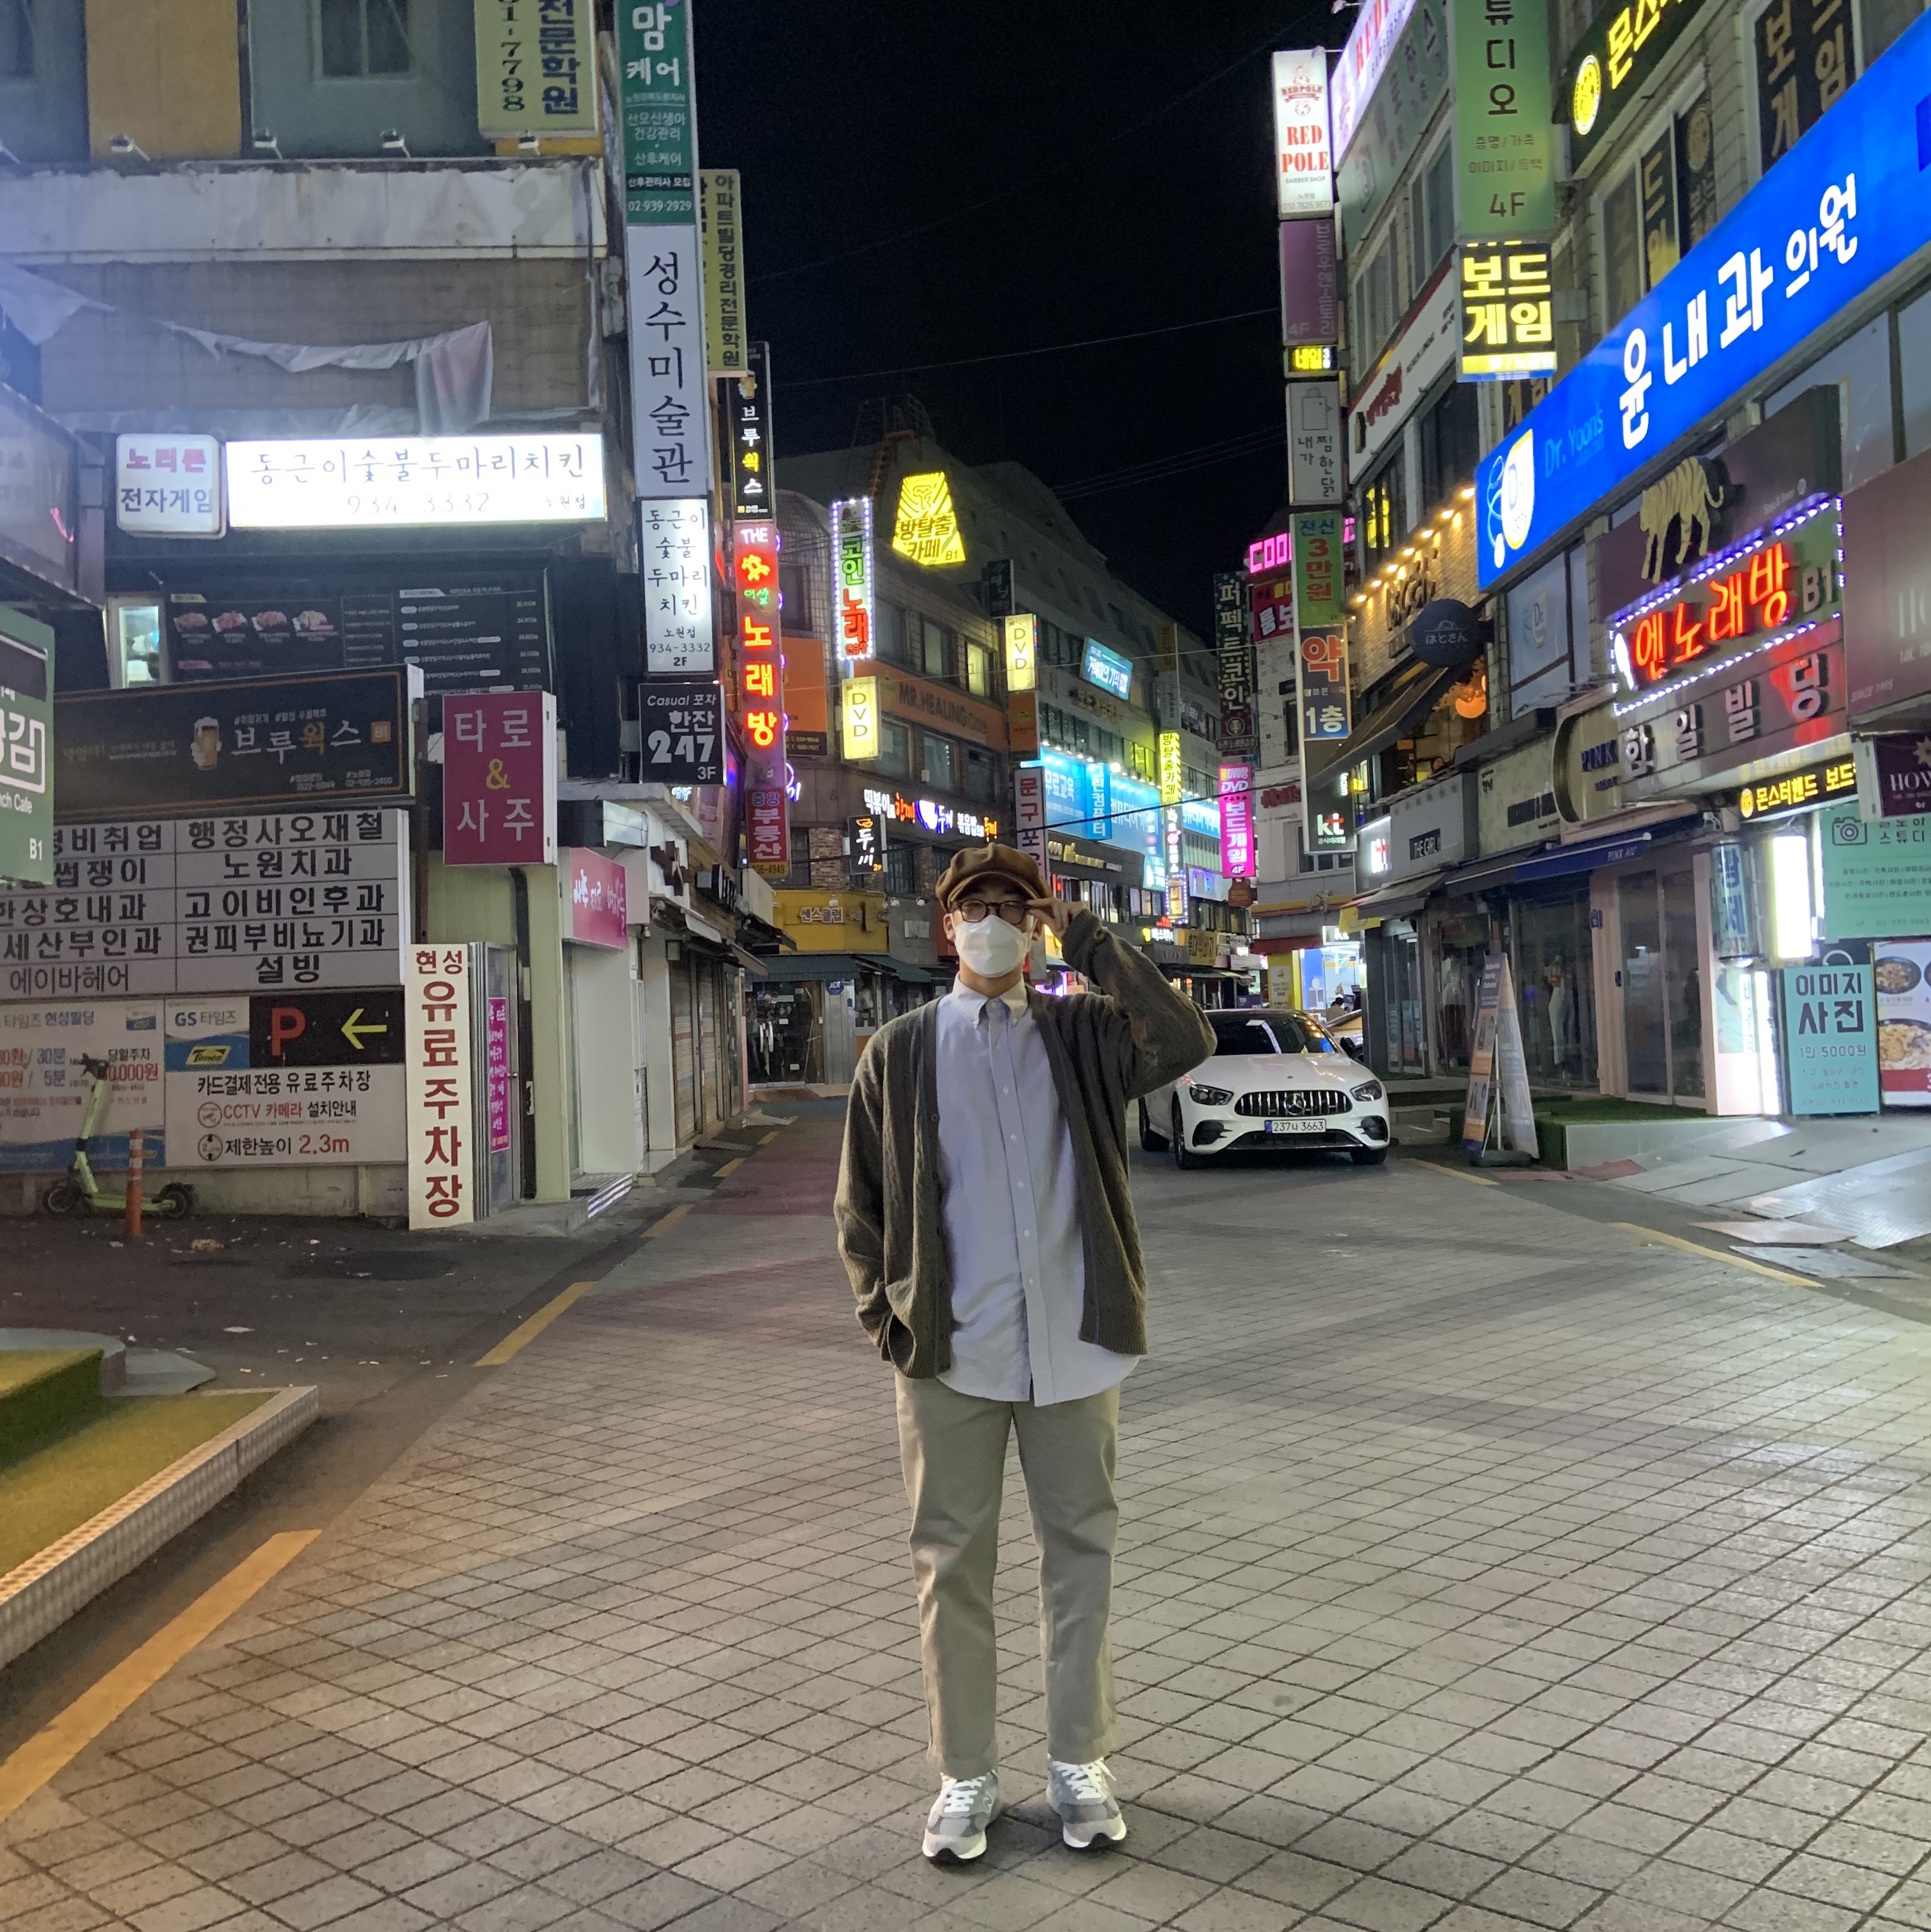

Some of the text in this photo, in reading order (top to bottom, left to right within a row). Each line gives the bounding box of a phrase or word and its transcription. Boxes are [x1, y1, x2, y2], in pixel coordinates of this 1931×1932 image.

[632, 3, 671, 50] 맘
[627, 57, 679, 86] 케어
[1287, 125, 1322, 146] RED
[1282, 151, 1328, 173] POLE
[1488, 192, 1525, 218] 4F
[1463, 254, 1551, 298] 보드
[1464, 300, 1552, 345] 게임
[643, 252, 693, 483] 성수미술관
[1294, 348, 1322, 370] 네일
[120, 488, 213, 514] 전자게임
[646, 507, 705, 529] 동근이
[900, 515, 951, 540] 방탈출
[655, 536, 696, 558] 숯불
[740, 528, 768, 544] THE
[840, 536, 865, 586] 코인
[907, 538, 958, 561] 카페 B1
[647, 565, 708, 588] 두마리
[1306, 538, 1333, 602] 3만원
[1802, 560, 1836, 612] B1
[660, 594, 698, 616] 치킨
[840, 588, 868, 643] 노래
[664, 627, 696, 638] 노원점
[650, 643, 710, 653] 934-3332
[1012, 628, 1027, 671] DVD
[1218, 582, 1245, 711] 퍼펙트코인
[1301, 635, 1344, 682] 약
[673, 657, 687, 666] 2F
[744, 614, 777, 747] 노래방
[647, 695, 690, 707] Casual
[851, 692, 868, 738] DVD
[1306, 705, 1345, 734] 1층
[454, 710, 531, 752] 타로
[647, 729, 715, 764] 247
[1581, 740, 1618, 772] PINK
[486, 759, 510, 790] &
[697, 766, 716, 780] 3F
[1826, 763, 1856, 791] 보드
[752, 791, 780, 807] 중앙
[1020, 777, 1038, 822] 문구
[1222, 780, 1249, 793] DVD
[188, 811, 383, 849] 행정사오재철
[457, 799, 534, 842] 사주
[1224, 803, 1246, 864] 보드게임
[1317, 813, 1344, 835] kt
[752, 808, 782, 860] 부동산
[1879, 831, 1931, 844] 스튜디
[29, 838, 43, 860] B1
[223, 848, 352, 879] 노원치과
[1231, 865, 1244, 874] 4F
[185, 885, 384, 918] 고이비인후과
[800, 907, 844, 923] 센스클럽
[186, 919, 384, 954] 권피부비뇨기과
[256, 955, 321, 984] 설빙
[416, 950, 463, 975] 현성
[10, 964, 128, 996] 에이바헤어
[829, 980, 841, 989] ADT
[1796, 973, 1861, 996] 이미지
[174, 1010, 238, 1026] GS 타임즈
[1799, 1000, 1864, 1035] 사진
[271, 1007, 307, 1056] P
[109, 1047, 151, 1062] 당일주차
[1822, 1044, 1866, 1058] 5000원
[197, 1074, 251, 1096] 카드결제
[285, 1070, 371, 1093] 유료주차장
[223, 1100, 357, 1118] CCTV 카메라 설치안내
[421, 980, 464, 1218] 유료주차장
[1301, 1122, 1323, 1130] 3663
[225, 1134, 349, 1156] 제한높이 2.3m
